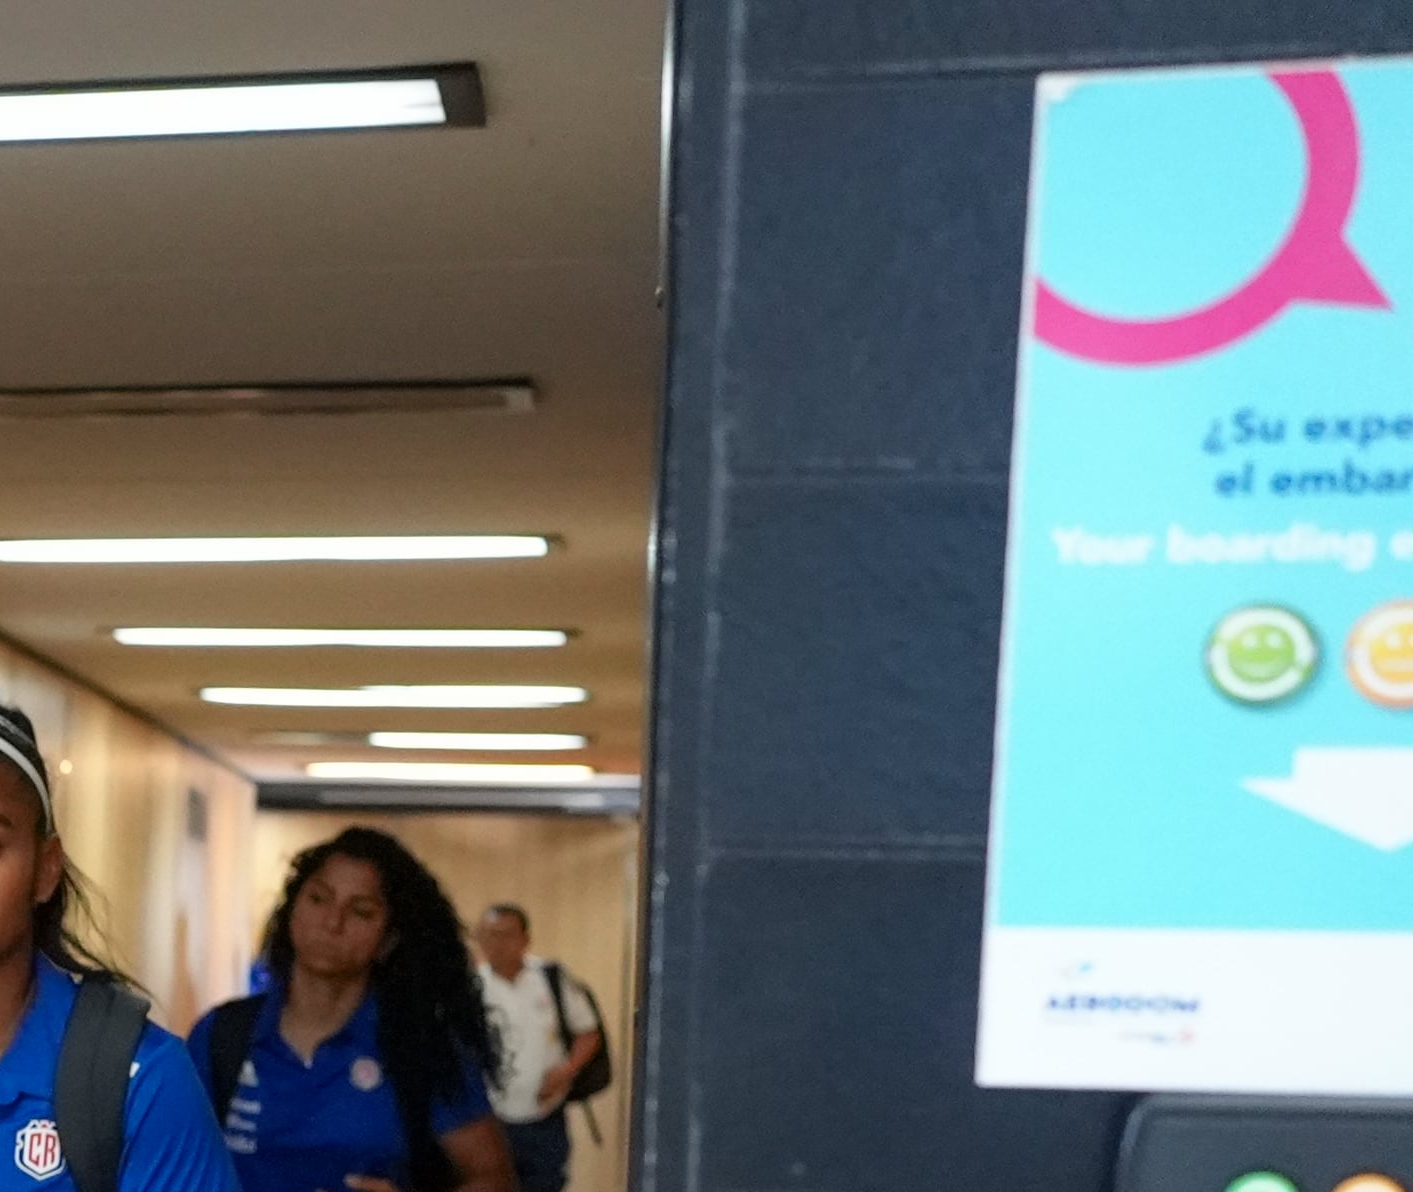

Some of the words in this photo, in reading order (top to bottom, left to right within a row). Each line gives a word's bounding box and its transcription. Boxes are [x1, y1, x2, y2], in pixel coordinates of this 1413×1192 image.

[1202, 408, 1286, 454] ¿Su
[1215, 461, 1254, 496] el
[1052, 525, 1154, 564] Your
[1168, 521, 1375, 571] boarding
[29, 1132, 56, 1167] CR
